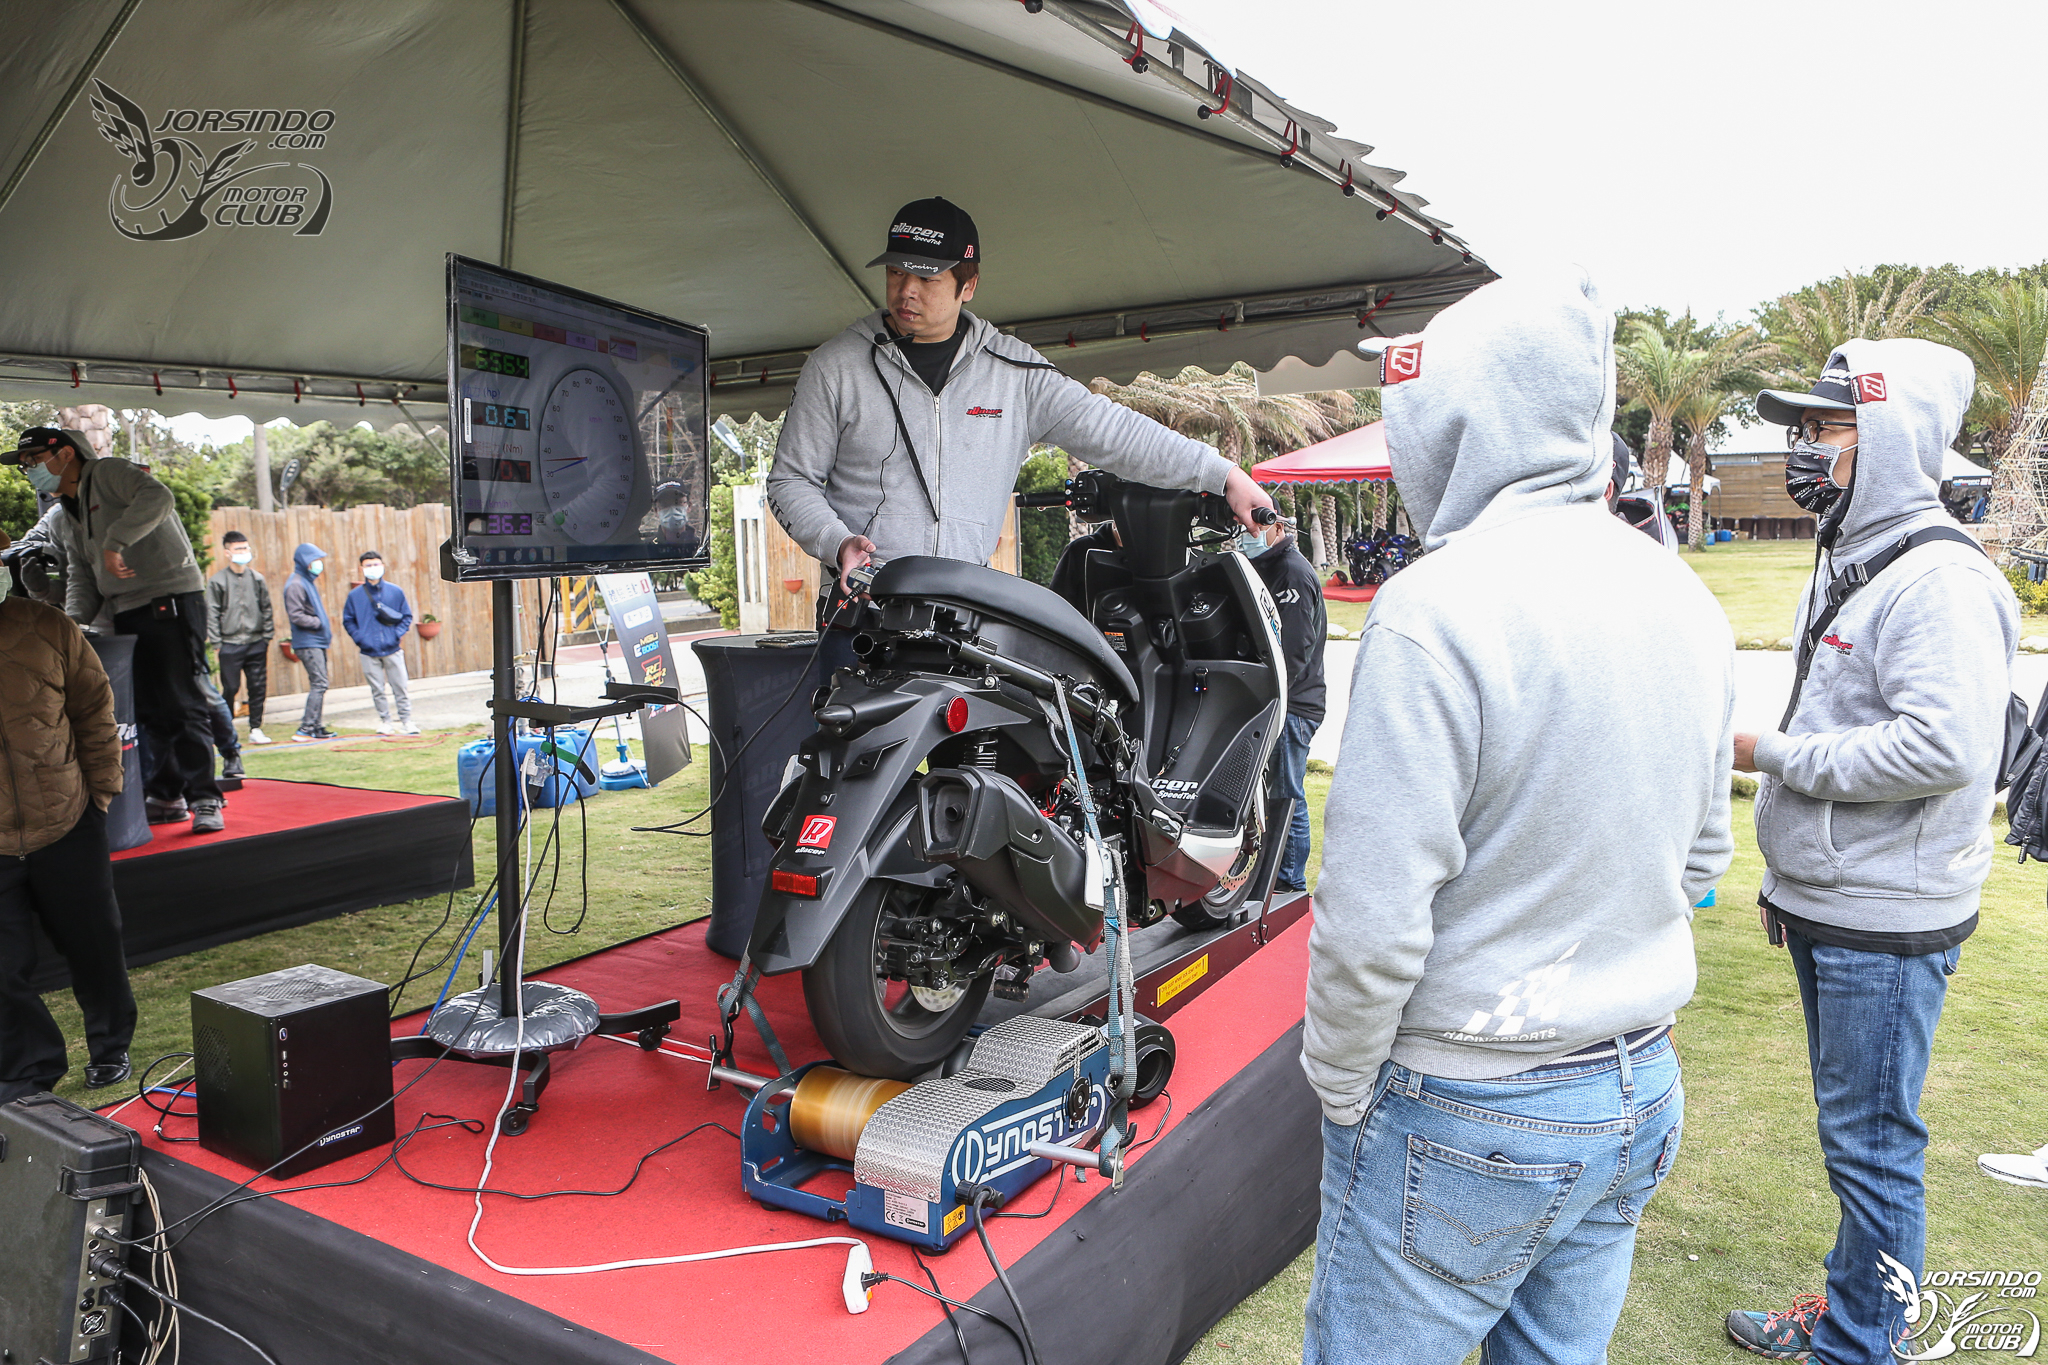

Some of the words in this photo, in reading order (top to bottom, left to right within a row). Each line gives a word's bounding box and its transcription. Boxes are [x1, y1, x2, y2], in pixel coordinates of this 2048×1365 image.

[475, 349, 529, 377] 6564
[485, 405, 530, 429] 0.67
[500, 460, 531, 480] 0.7
[552, 491, 560, 499] 20
[488, 514, 532, 534] 36.2
[1149, 777, 1199, 792] cer
[1157, 790, 1198, 800] SpeedTek
[954, 1094, 1099, 1184] DYNOSTR
